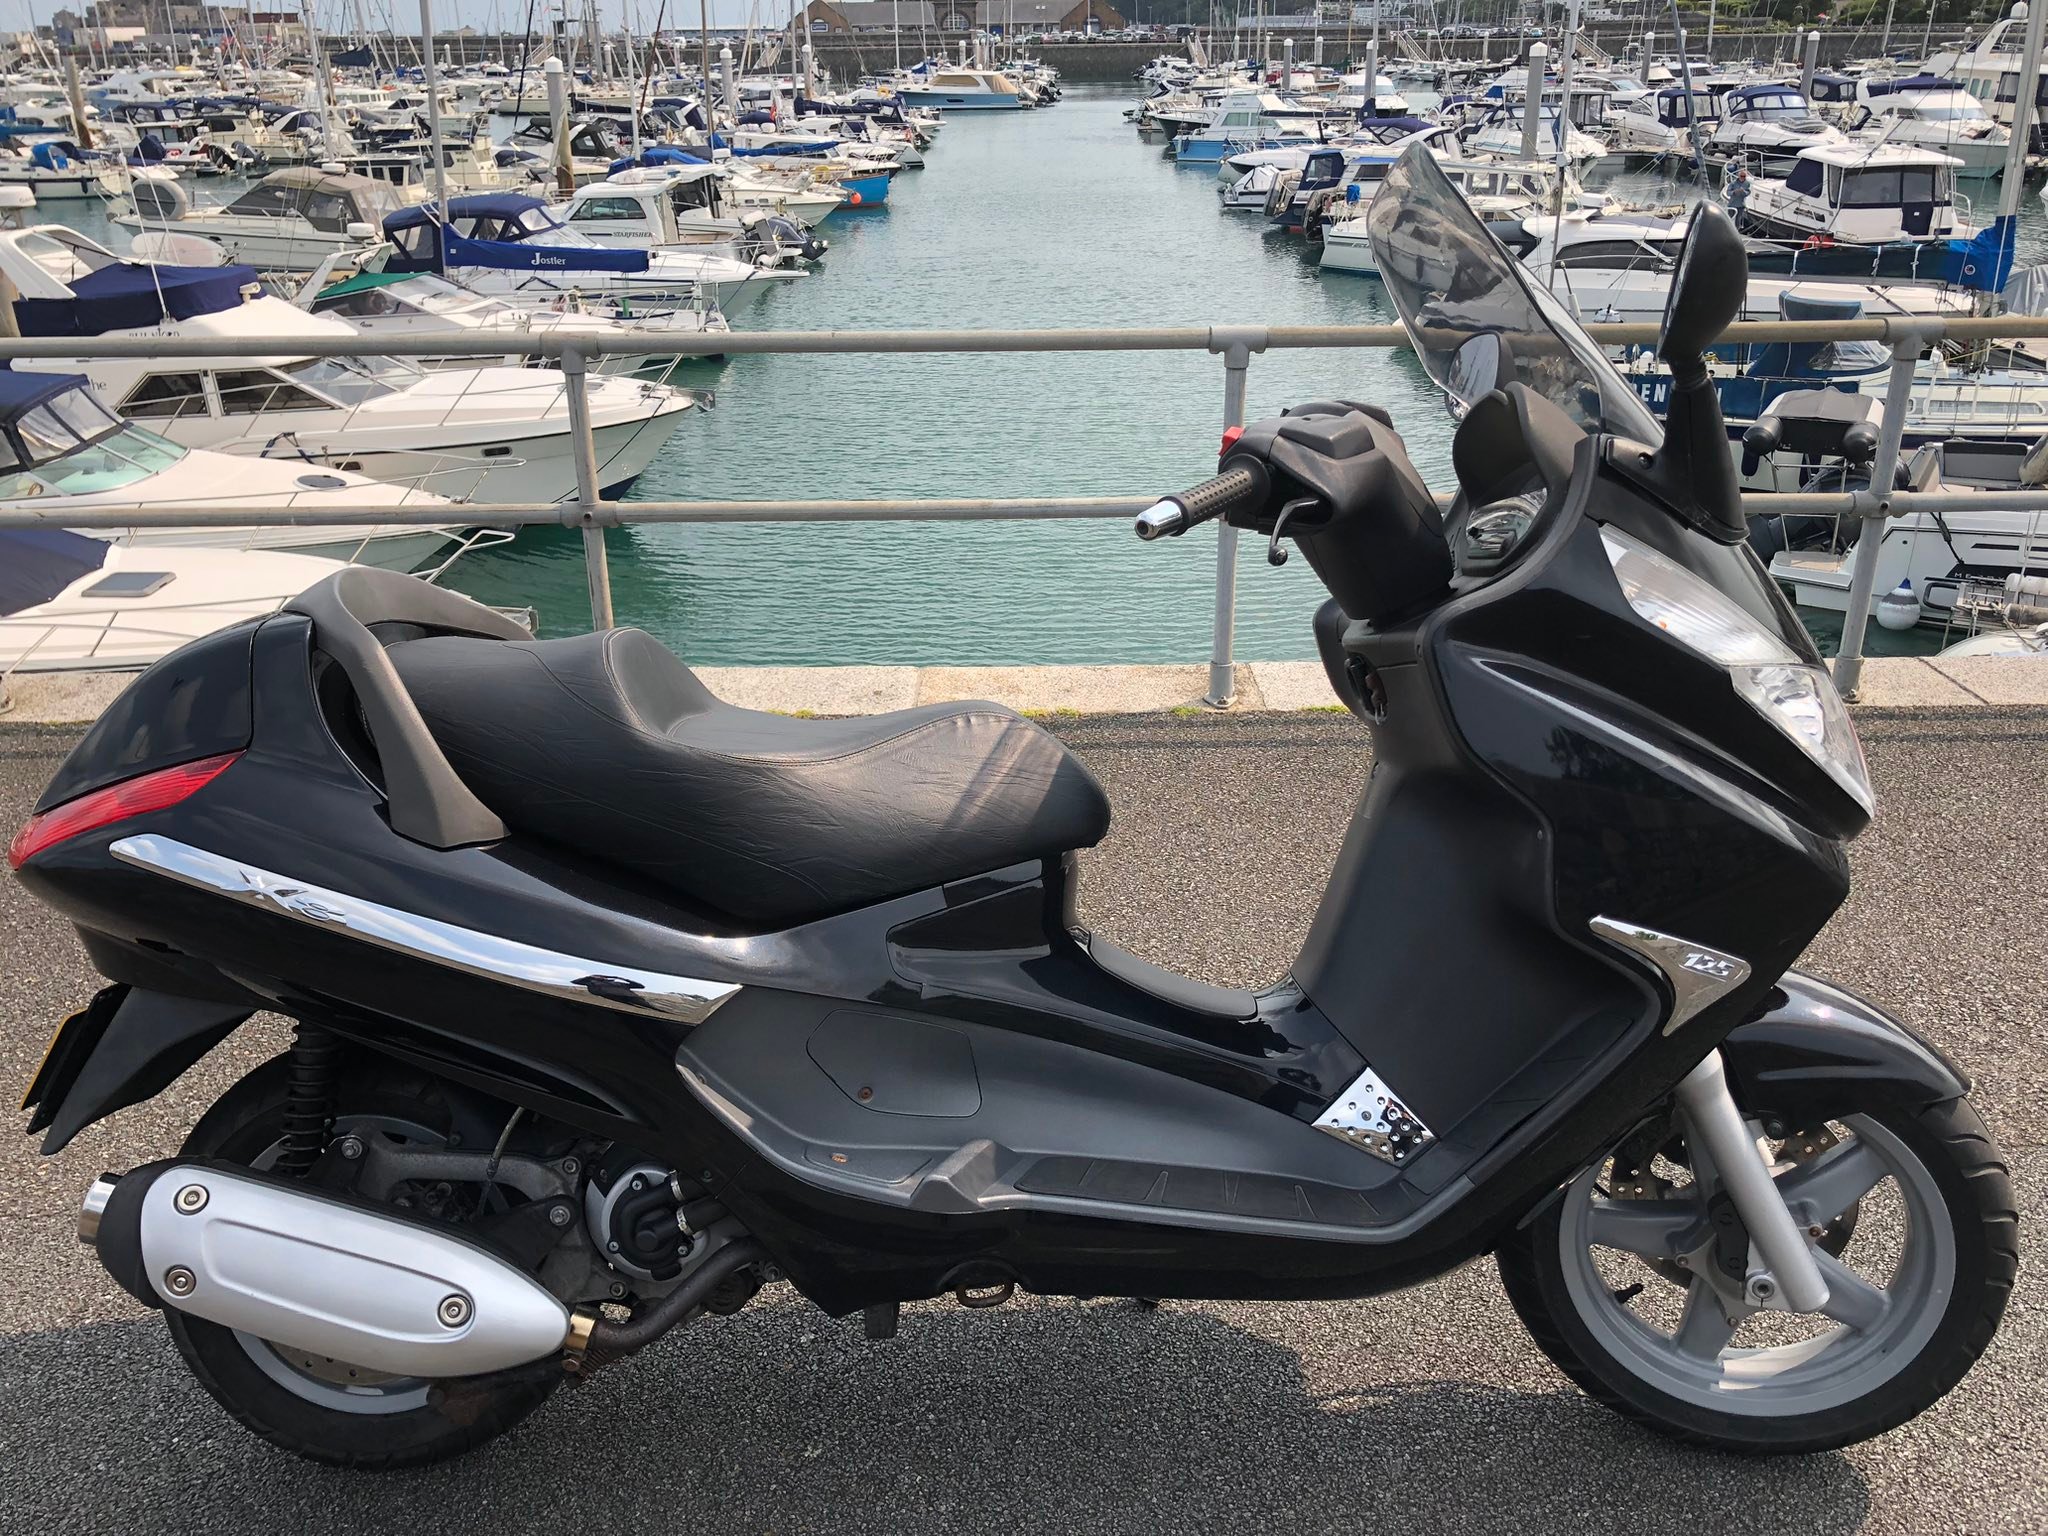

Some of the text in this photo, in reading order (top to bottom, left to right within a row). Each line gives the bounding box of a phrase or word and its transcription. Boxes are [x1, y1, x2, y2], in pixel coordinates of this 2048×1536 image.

[531, 252, 567, 266] Jostler
[1632, 383, 1667, 402] EN
[1683, 952, 1736, 977] 125
